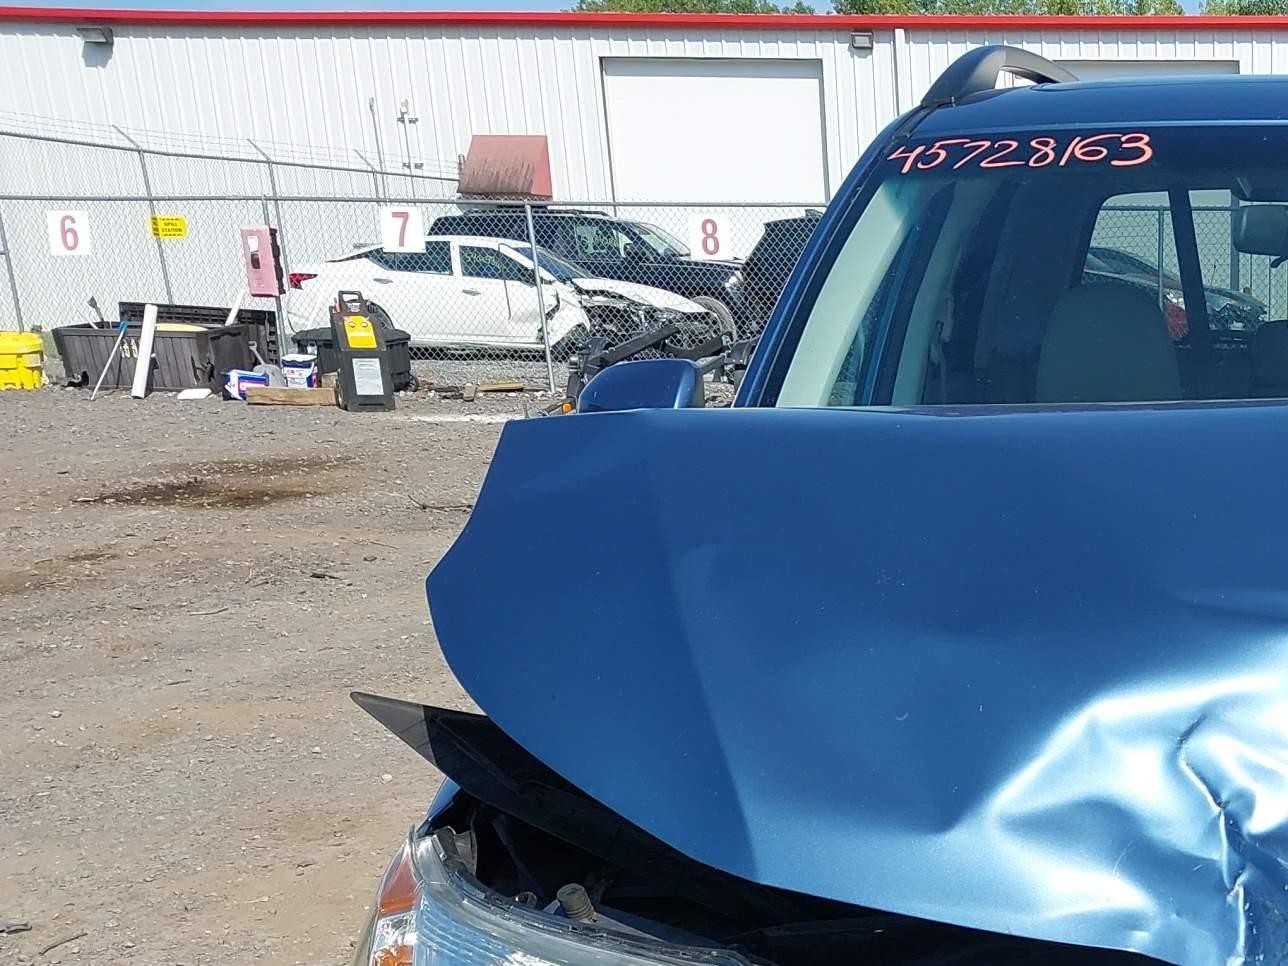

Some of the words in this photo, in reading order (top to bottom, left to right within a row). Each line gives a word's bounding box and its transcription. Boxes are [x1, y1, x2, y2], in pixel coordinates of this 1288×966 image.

[887, 133, 1153, 174] 45728163
[60, 214, 79, 251] 6
[391, 211, 409, 248] 7
[701, 218, 720, 256] 8
